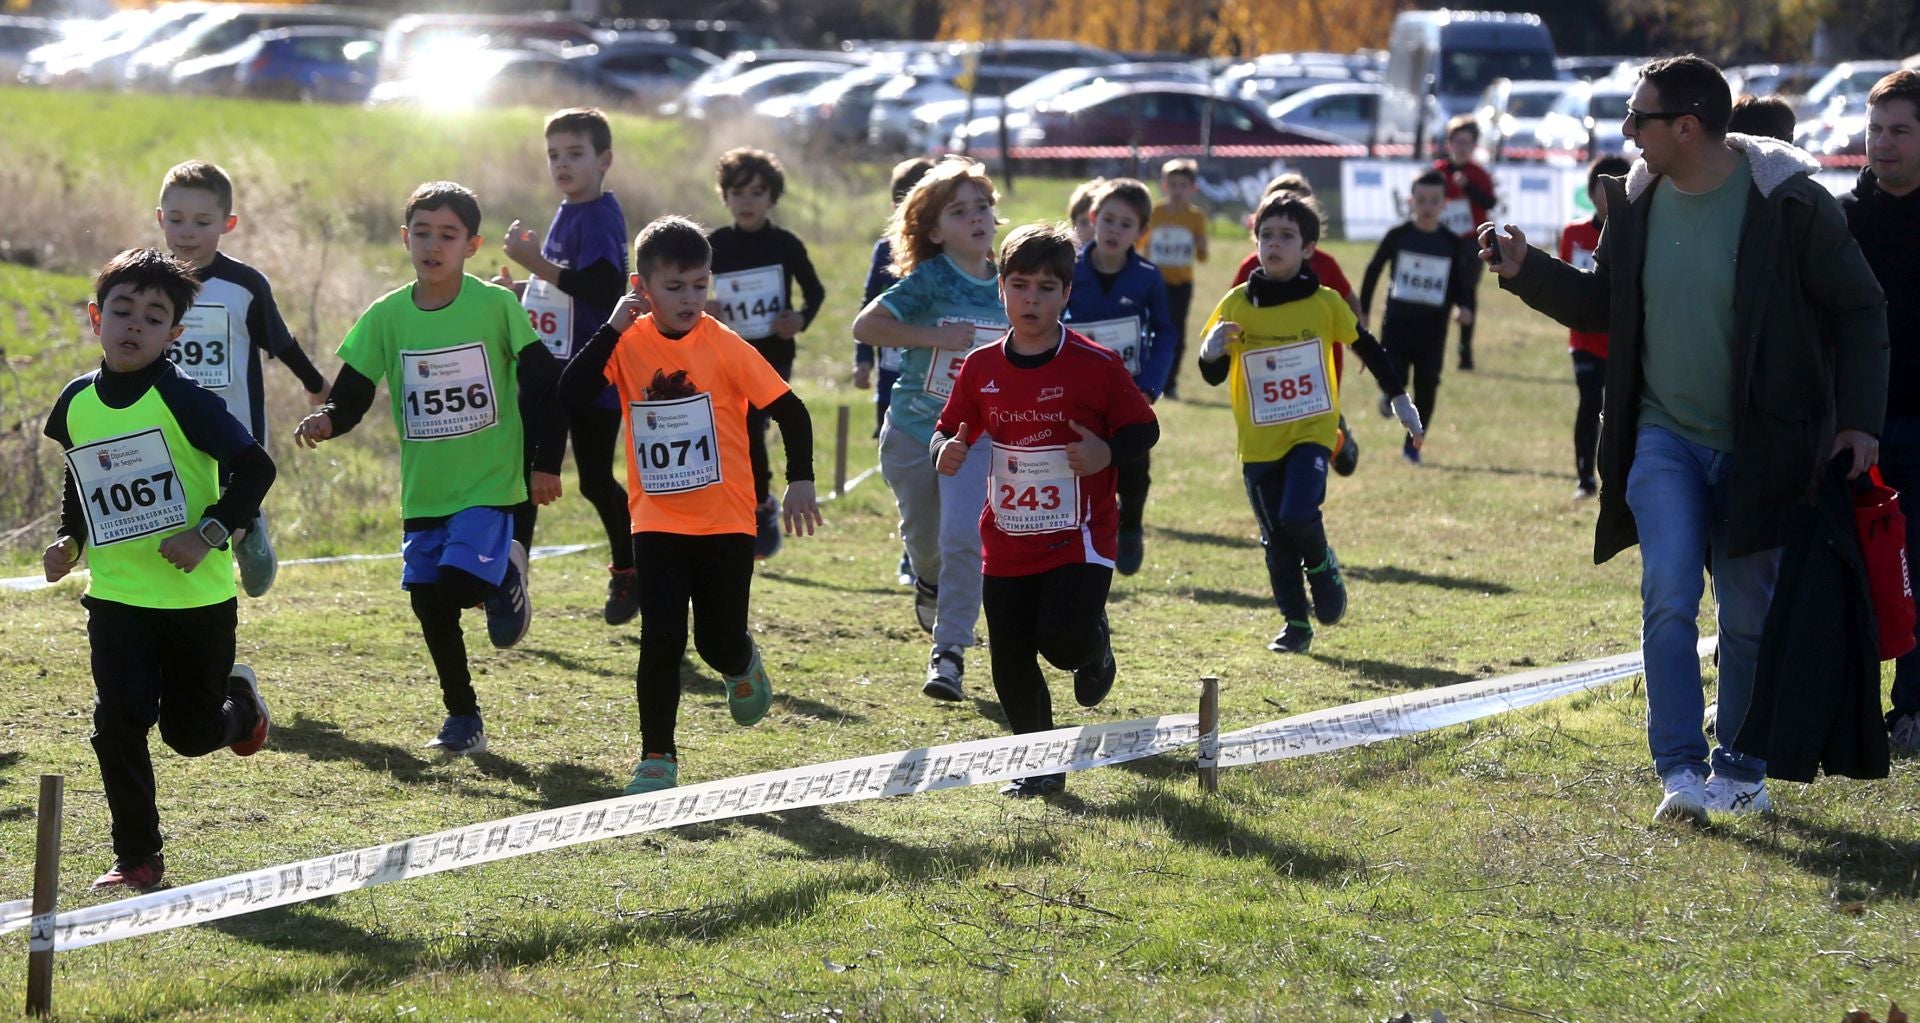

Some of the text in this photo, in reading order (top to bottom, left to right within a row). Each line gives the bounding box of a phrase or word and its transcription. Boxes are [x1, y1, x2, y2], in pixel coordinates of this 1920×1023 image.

[723, 296, 780, 321] 1144
[167, 341, 225, 366] 693
[407, 383, 488, 416] 1556
[1263, 373, 1313, 403] 585
[443, 414, 478, 425] NACIONAL
[1000, 409, 1065, 423] CrisCloset
[1016, 429, 1052, 447] HIDALGO
[110, 448, 139, 460] Diputación
[120, 457, 143, 467] Segovia
[638, 434, 711, 469] 1071
[669, 468, 705, 479] NACIONAL
[91, 470, 174, 516] 1067
[1000, 484, 1061, 511] 243
[100, 521, 114, 530] LIII
[115, 517, 136, 527] CROSS
[136, 508, 173, 522] NACIONAL
[104, 513, 185, 539] CANTIMPALOS 2025
[1025, 513, 1059, 522] NACIONAL
